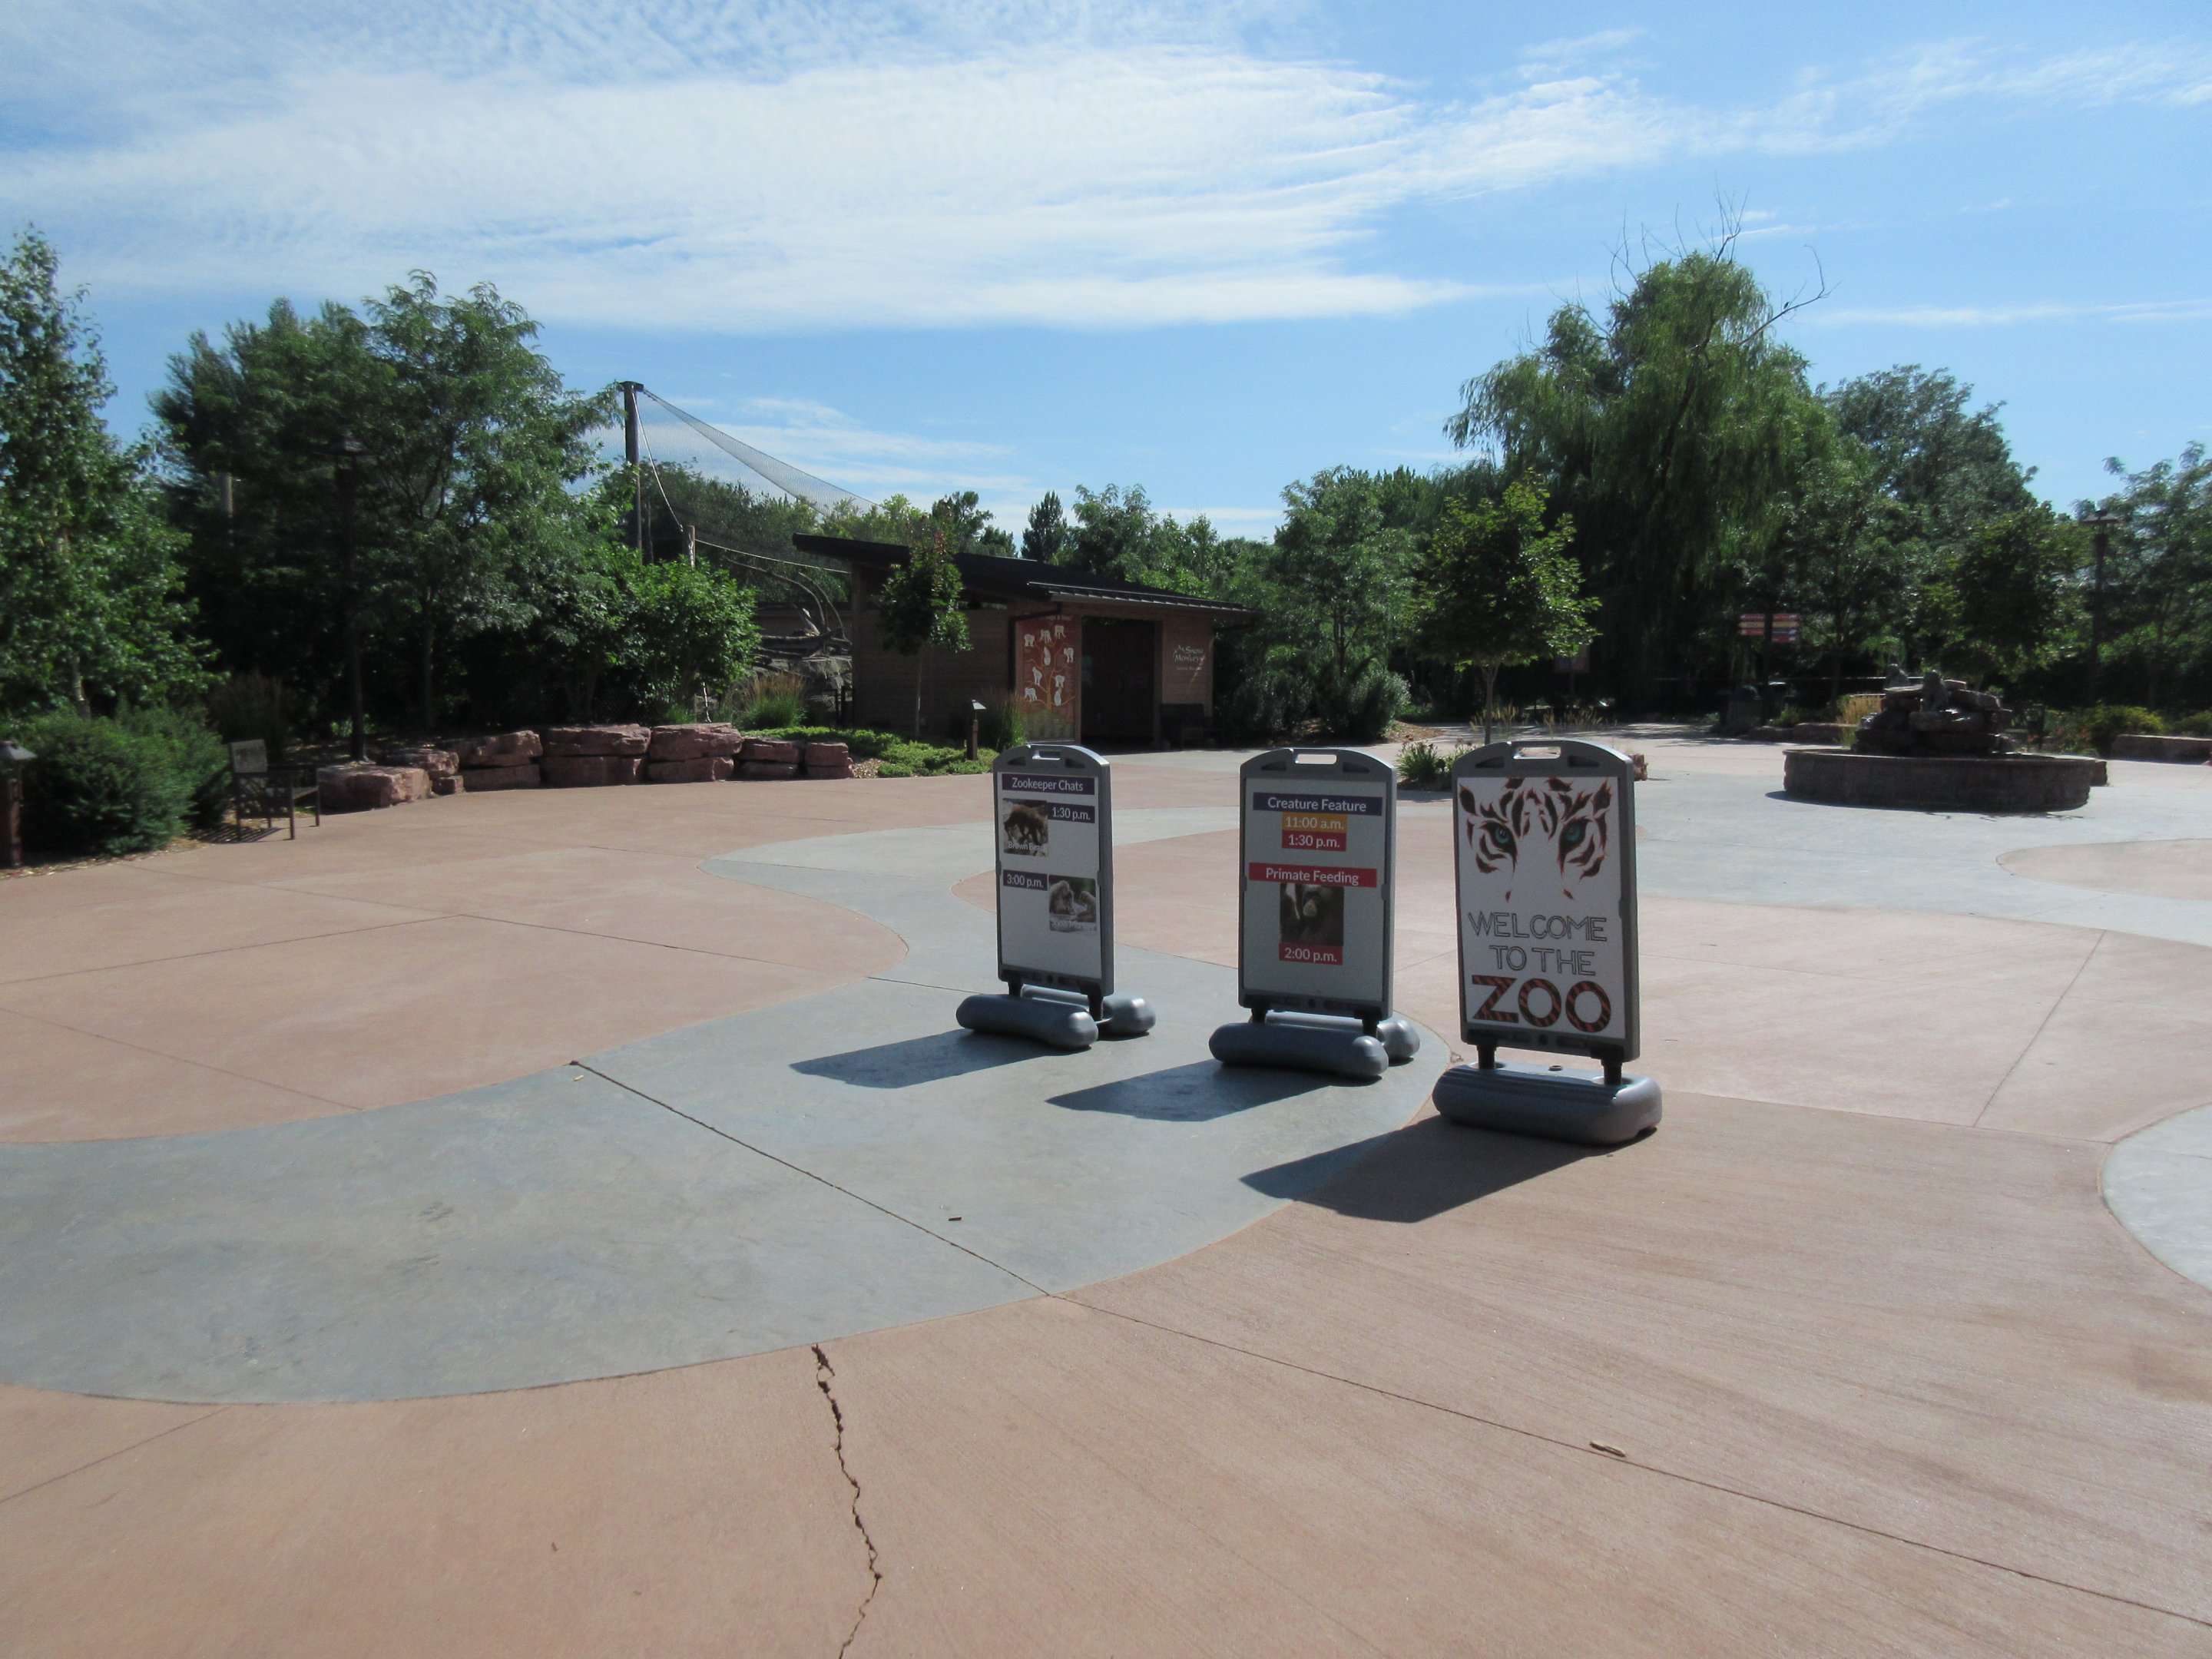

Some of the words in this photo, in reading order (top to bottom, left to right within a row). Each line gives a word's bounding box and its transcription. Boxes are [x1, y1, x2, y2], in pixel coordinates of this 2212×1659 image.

[1012, 777, 1056, 790] Zookeeper
[1058, 780, 1084, 792] Chats
[1267, 796, 1318, 810] Creature
[1321, 799, 1366, 812] Feature
[1051, 806, 1071, 818] 1:30
[1071, 810, 1091, 822] p.m.
[1286, 816, 1318, 829] 11:00
[1320, 820, 1344, 830] a.m.
[1288, 834, 1313, 846] 1:30
[1316, 837, 1340, 849] p.m.
[1007, 874, 1025, 886] 3:00
[1026, 877, 1044, 889] p.m.
[1266, 867, 1310, 882] Primate
[1313, 870, 1359, 886] Feeding
[1468, 912, 1608, 942] WELCOME
[1284, 947, 1310, 959] 2:00
[1313, 951, 1337, 963] p.m.
[1488, 945, 1527, 971] TO
[1532, 947, 1596, 976] THE
[1472, 975, 1611, 1033] ZOO
